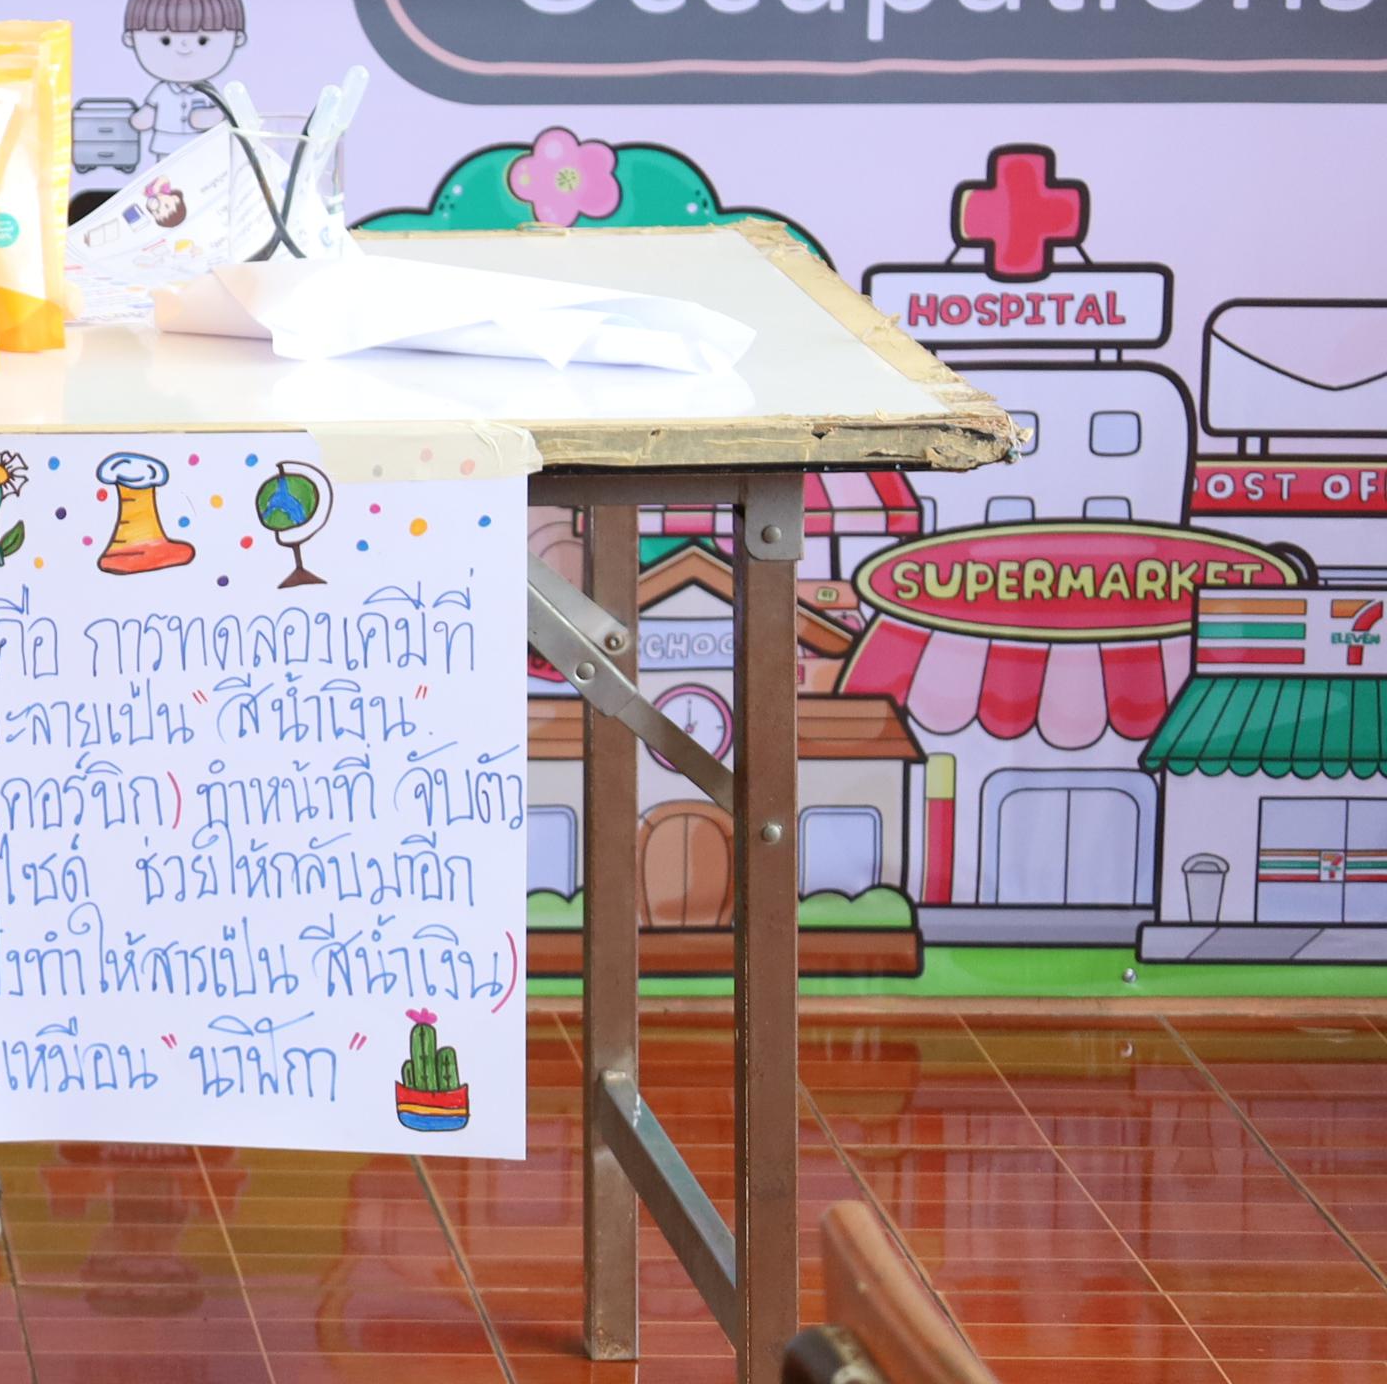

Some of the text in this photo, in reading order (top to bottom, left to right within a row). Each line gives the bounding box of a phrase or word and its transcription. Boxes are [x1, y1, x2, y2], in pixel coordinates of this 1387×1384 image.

[907, 290, 1127, 327] HOSPITAL
[1193, 470, 1387, 503] OST OF
[892, 558, 1263, 602] SUPERMARKET
[638, 632, 734, 659] CHOO
